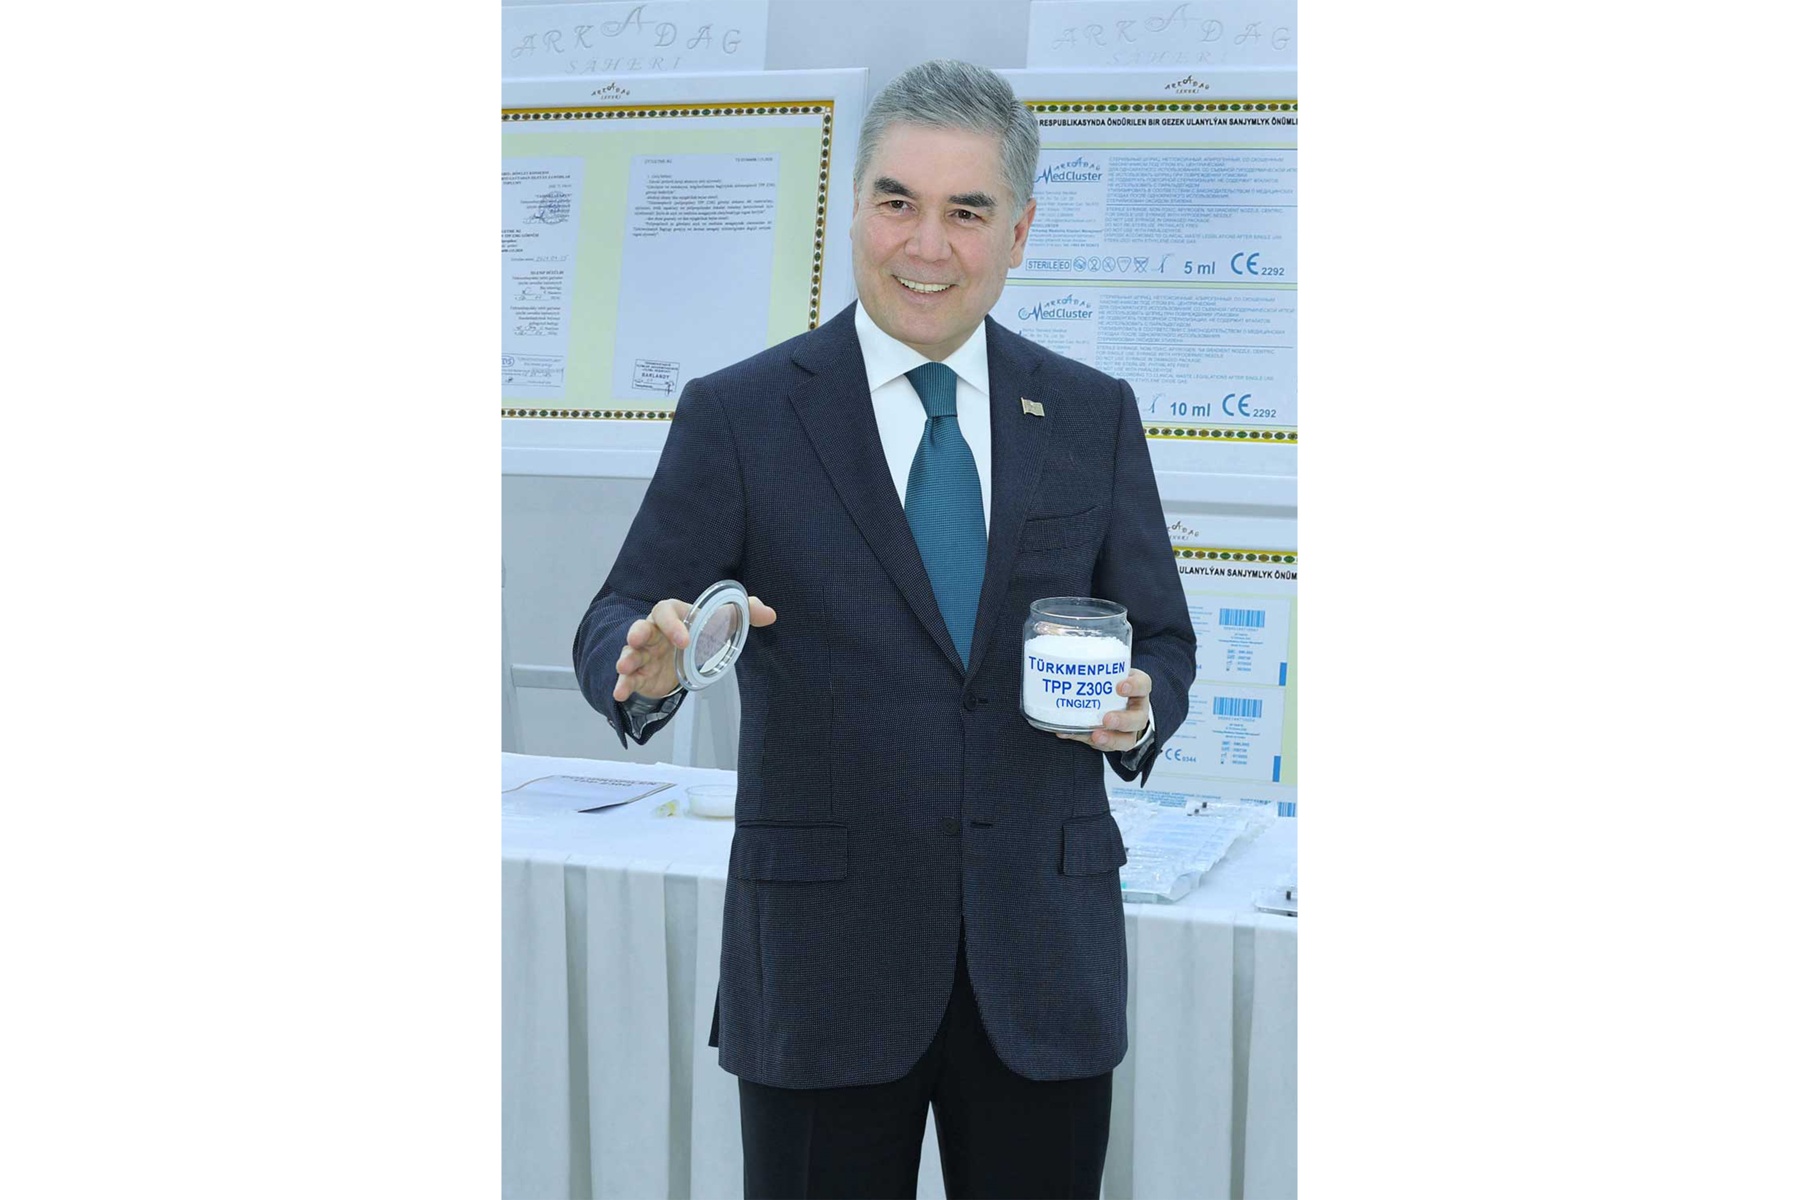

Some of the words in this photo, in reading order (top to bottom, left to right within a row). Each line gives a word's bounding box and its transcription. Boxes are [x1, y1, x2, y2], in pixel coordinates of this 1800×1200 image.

[510, 4, 742, 58] ARKADAG
[1052, 3, 1292, 50] ARKADAG
[1039, 119, 1106, 127] RESPUBLIKASYNDA
[1148, 118, 1160, 126] BIR
[1161, 118, 1185, 126] GEZEK
[1229, 117, 1270, 126] SANJYMLYK
[1037, 165, 1103, 184] MedCluster
[1028, 261, 1057, 269] STERILE
[1184, 261, 1193, 274] 5
[1197, 261, 1215, 274] ml
[1230, 252, 1260, 275] CE
[1261, 267, 1285, 276] 2292
[1033, 302, 1093, 321] MedCluster
[1170, 402, 1187, 416] 10
[1192, 403, 1211, 417] ml
[1222, 393, 1252, 417] CE
[1253, 408, 1277, 418] 2292
[1227, 568, 1273, 579] SANJYMLYK
[1028, 656, 1126, 676] TÜRKMENPLEN
[1042, 678, 1072, 695] TPP
[1076, 681, 1113, 696] Z30G
[1056, 698, 1101, 710] (TNGIZT)
[1165, 748, 1182, 761] CE
